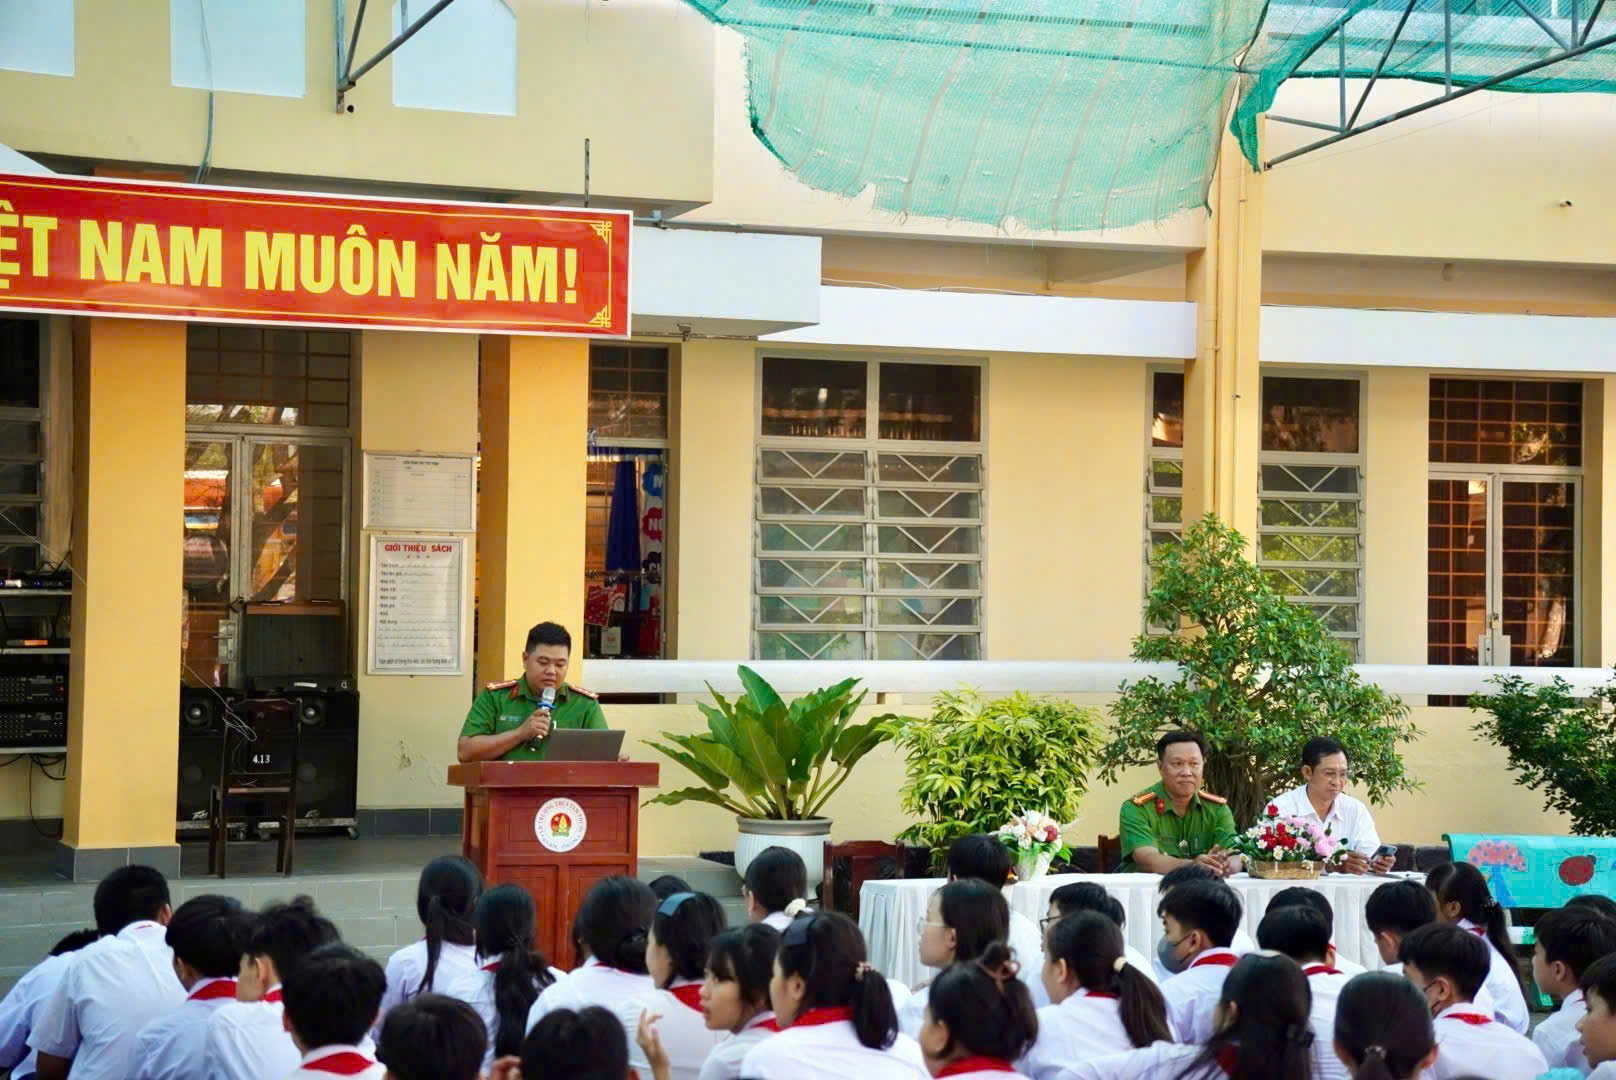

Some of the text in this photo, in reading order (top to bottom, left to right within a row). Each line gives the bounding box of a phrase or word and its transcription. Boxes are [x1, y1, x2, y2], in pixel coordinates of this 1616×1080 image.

[80, 219, 222, 288] NAM
[244, 225, 416, 298] MUÔN
[436, 232, 577, 303] NĂM!
[384, 543, 452, 554] GIỚI THIỆU SÁCH
[252, 754, 271, 764] 4.13
